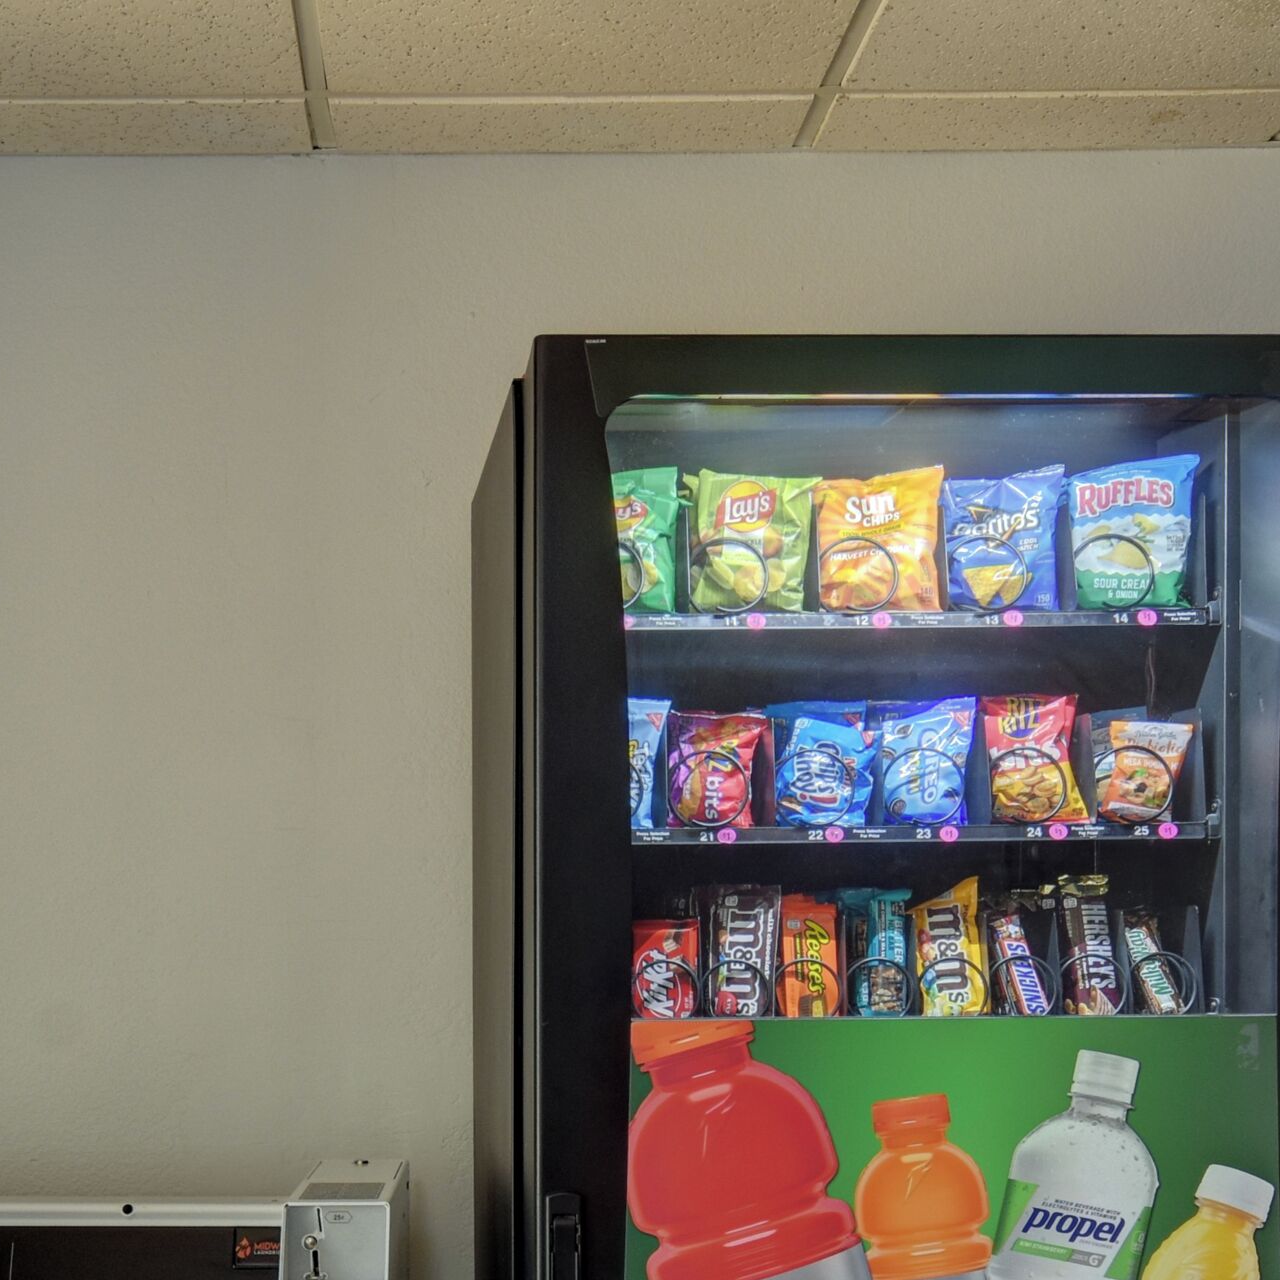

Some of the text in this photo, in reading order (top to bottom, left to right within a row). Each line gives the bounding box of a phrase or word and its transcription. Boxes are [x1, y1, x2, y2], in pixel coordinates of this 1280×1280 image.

[1077, 477, 1175, 516] RUFFLES
[724, 492, 770, 522] Lay's
[845, 491, 894, 523] Sun
[863, 511, 900, 527] CHIPS
[1093, 578, 1154, 590] SOUR CREA
[1116, 590, 1139, 599] ONION
[854, 616, 869, 626] 12
[984, 615, 999, 625] 13
[1113, 614, 1129, 624] 14
[919, 728, 940, 804] OREO
[704, 775, 725, 819] bits
[700, 832, 714, 841] 21
[808, 831, 824, 840] 22
[916, 829, 932, 839] 23
[1026, 826, 1042, 837] 24
[1134, 826, 1150, 836] 25
[1080, 904, 1117, 989] HERSHEY'S
[803, 919, 830, 995] Reese's
[1042, 1201, 1084, 1214] ELECTROLYTES
[1090, 1211, 1117, 1220] VITAMINS
[1074, 1202, 1105, 1213] BEVERAGE
[1021, 1207, 1125, 1243] propel
[1088, 1255, 1100, 1266] G
